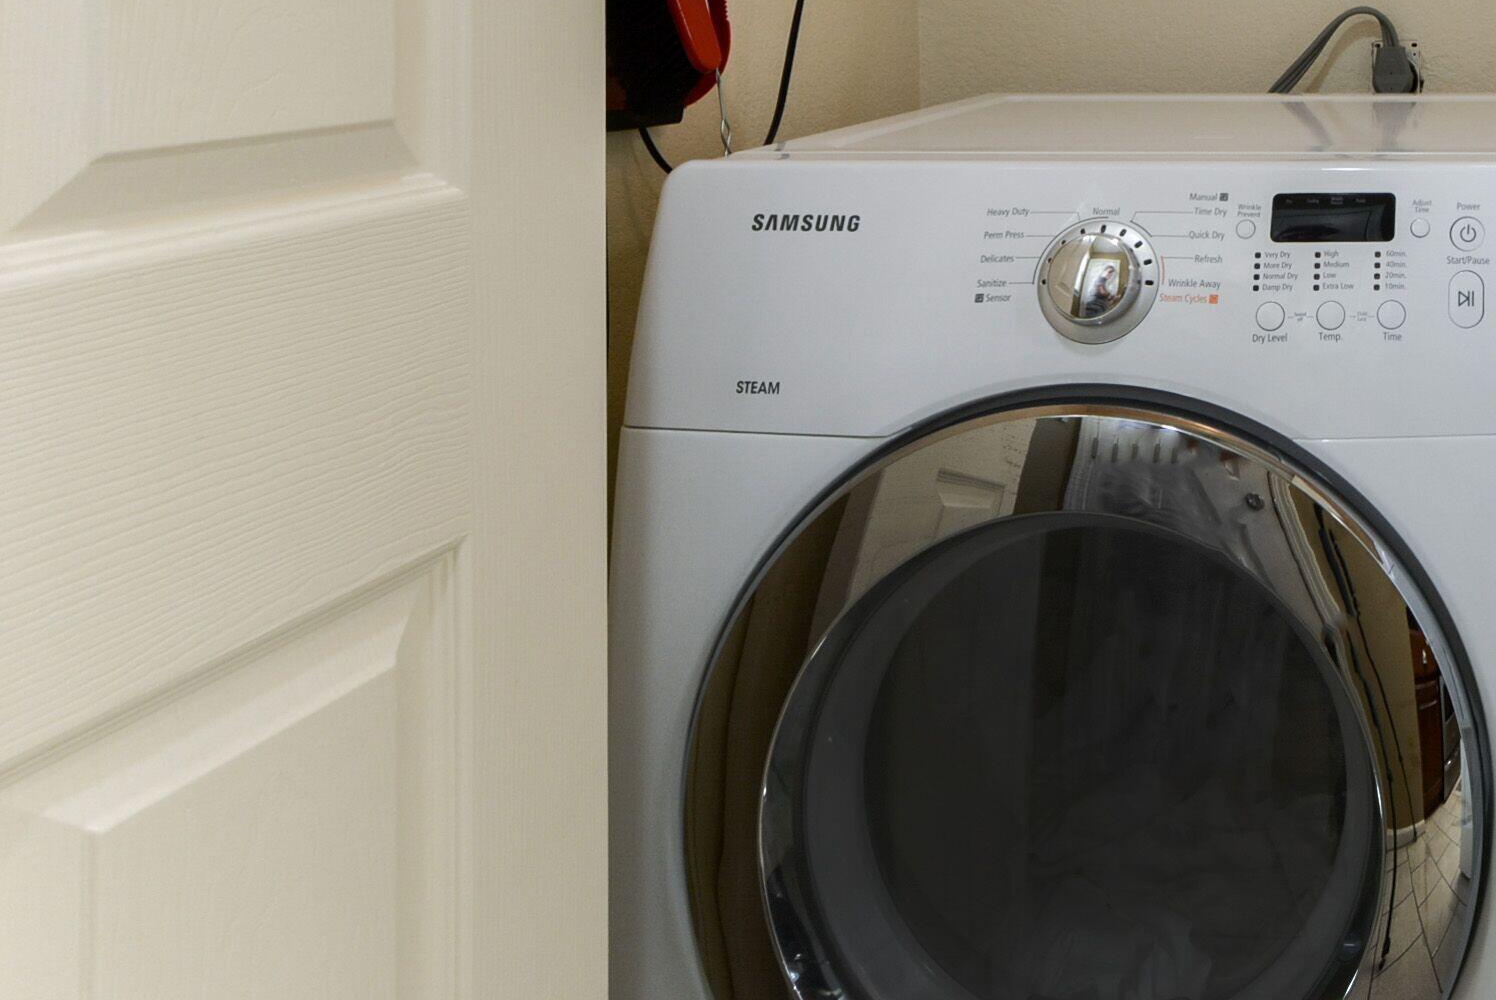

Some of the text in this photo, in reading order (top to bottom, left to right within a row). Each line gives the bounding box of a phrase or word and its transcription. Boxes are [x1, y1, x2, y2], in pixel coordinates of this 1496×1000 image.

[1189, 193, 1217, 202] Manual
[1412, 199, 1432, 208] Adjust
[1456, 202, 1481, 211] Power
[986, 208, 1030, 217] Heavy Duty
[1092, 207, 1120, 216] Normal
[1194, 208, 1228, 218] Time Dry
[751, 213, 861, 232] SAMSUNG
[983, 231, 1025, 240] Perm Press
[1189, 230, 1225, 241] Quick Dry
[980, 254, 1014, 263] Delicates
[1194, 254, 1222, 263] Refresh
[1264, 251, 1291, 260] Very Dry
[1324, 250, 1339, 259] High
[1447, 256, 1490, 266] Start/Pause
[1280, 262, 1292, 270] Dry
[1263, 272, 1298, 281] Normal Dry
[977, 279, 1007, 288] Sanitize
[1168, 279, 1221, 289] Wrinkle Away
[1262, 283, 1293, 292] Damp Dry
[985, 294, 1011, 302] Sensor
[1159, 294, 1208, 304] Steam Cycles
[1252, 333, 1288, 344] Dry Level
[1319, 332, 1343, 342] Temp.
[1383, 332, 1402, 341] Time
[736, 380, 780, 395] STEAM
